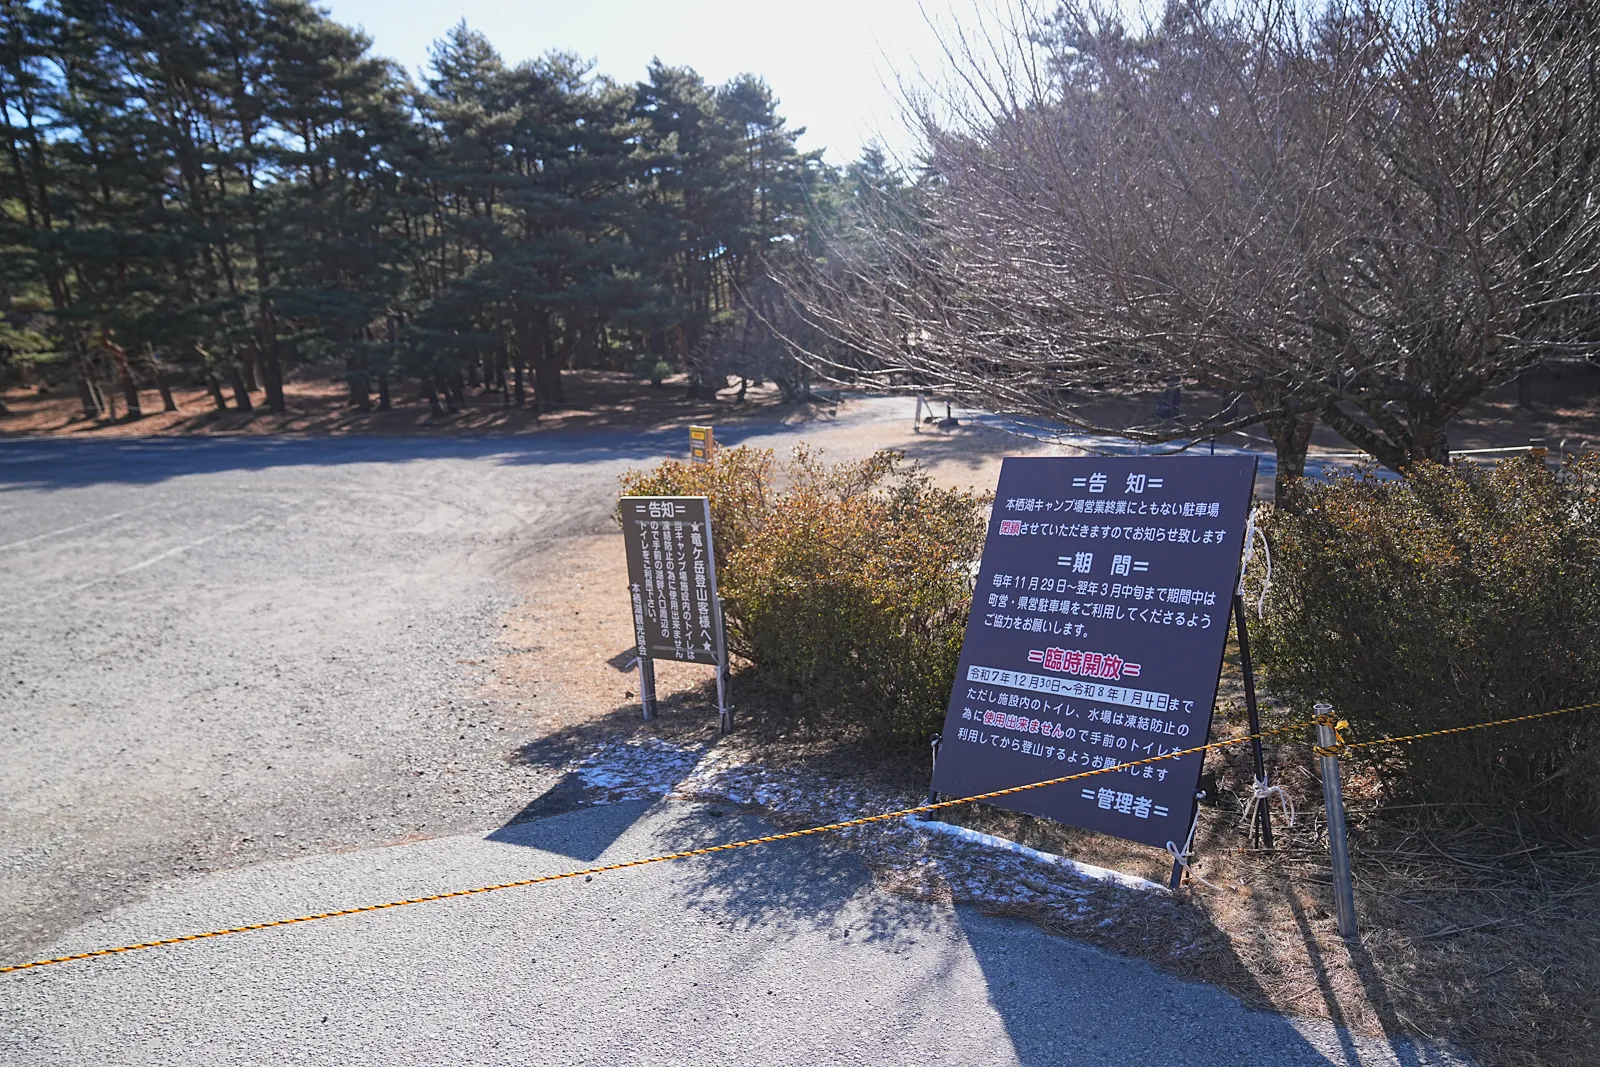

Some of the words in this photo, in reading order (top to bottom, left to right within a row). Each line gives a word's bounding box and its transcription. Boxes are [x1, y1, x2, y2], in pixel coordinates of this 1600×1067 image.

[1005, 497, 1220, 518] 本栖湖キャンプ場営業終業にともない駐車場
[999, 520, 1226, 544] 閉鎖させていただきますのでお知らせ致します
[984, 612, 1089, 639] ご協力をお願いします。
[966, 687, 1190, 737] ただし施設内のトイレ、水場は凍結防止の
